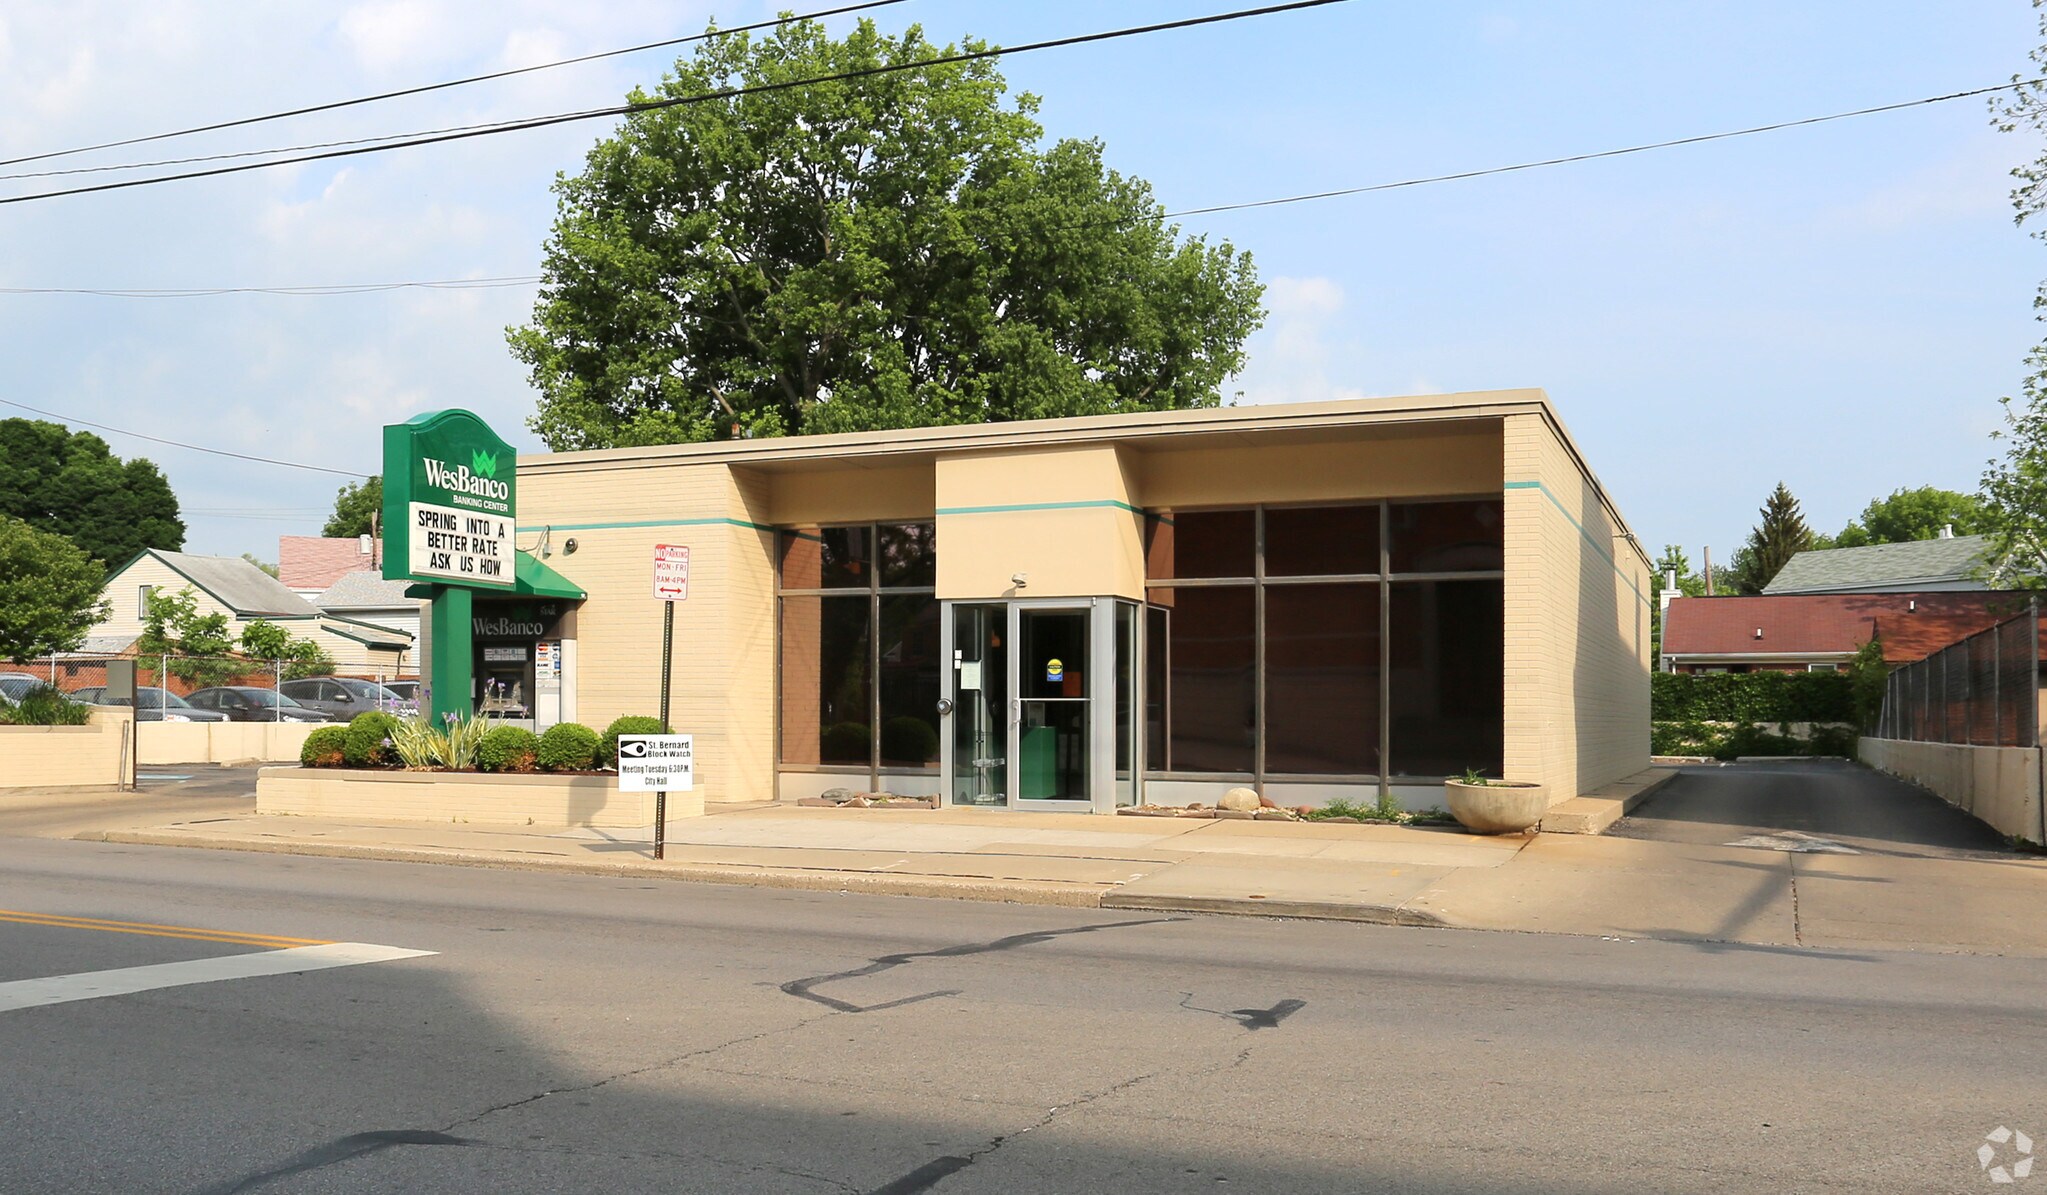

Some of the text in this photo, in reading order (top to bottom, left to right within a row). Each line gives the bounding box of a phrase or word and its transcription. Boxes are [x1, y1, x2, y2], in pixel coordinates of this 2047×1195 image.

[423, 457, 508, 500] WesBanco
[453, 495, 508, 512] BANKING CENTER
[418, 510, 505, 539] SPRING INTO A
[428, 531, 498, 556] BETTER RATE
[656, 548, 665, 559] NO
[430, 552, 501, 576] ASK US HOW
[473, 618, 543, 635] WesBanco
[622, 765, 644, 774] Meeting
[645, 764, 667, 774] Tuesday
[645, 777, 655, 786] City
